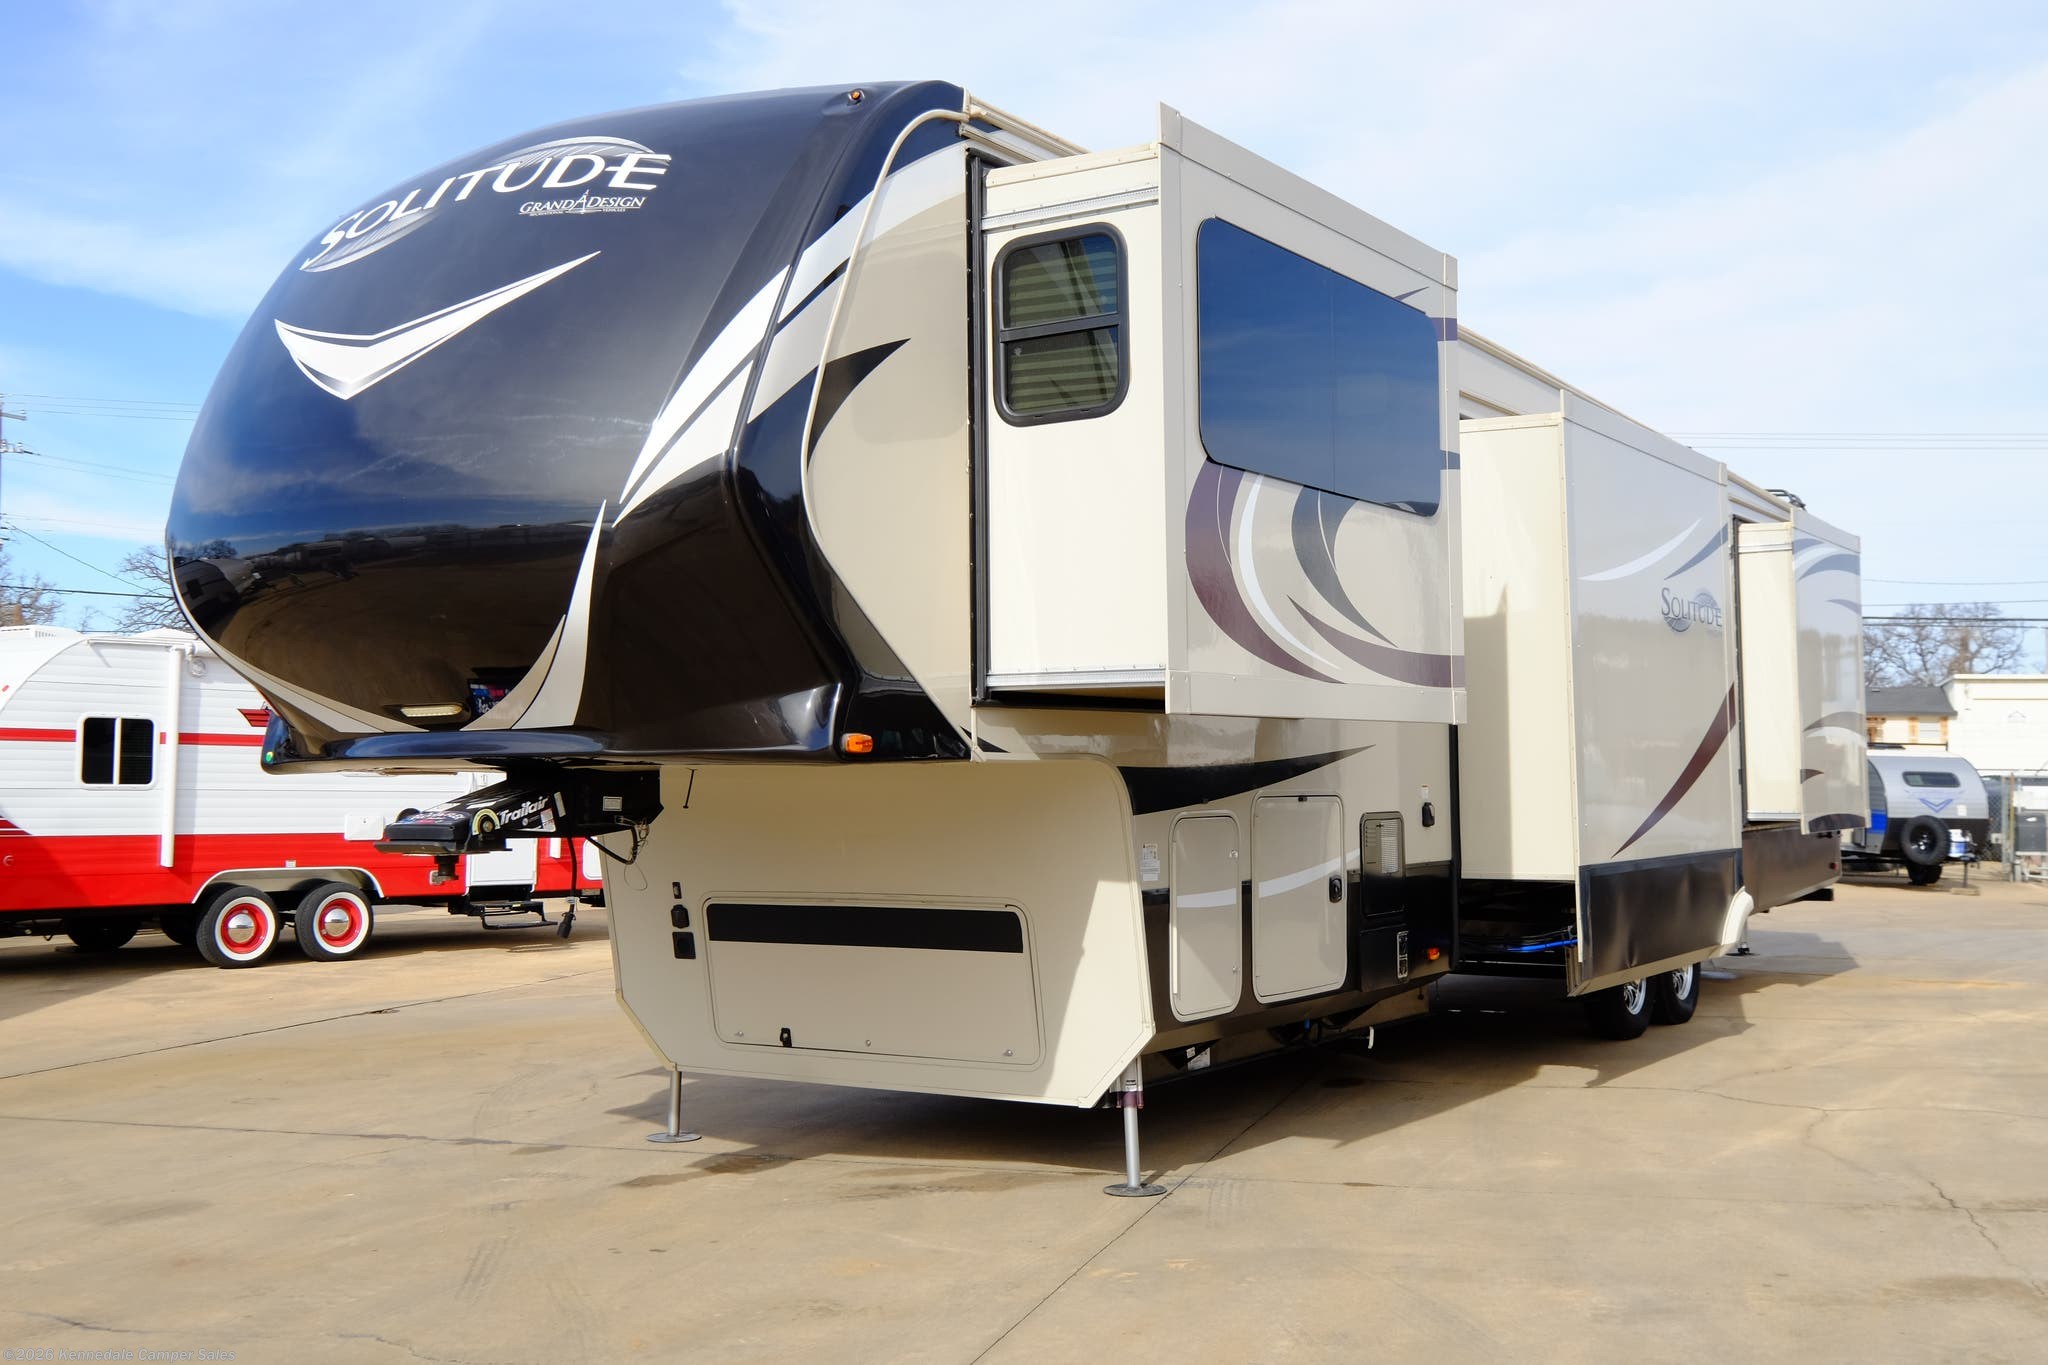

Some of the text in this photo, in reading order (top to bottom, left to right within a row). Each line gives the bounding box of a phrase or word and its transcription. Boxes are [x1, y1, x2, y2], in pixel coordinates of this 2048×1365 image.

[299, 153, 672, 270] SOLITUDE
[519, 196, 647, 213] GRAND DESIGN
[1661, 587, 1722, 627] SOLITUDE
[499, 796, 549, 826] Trailair
